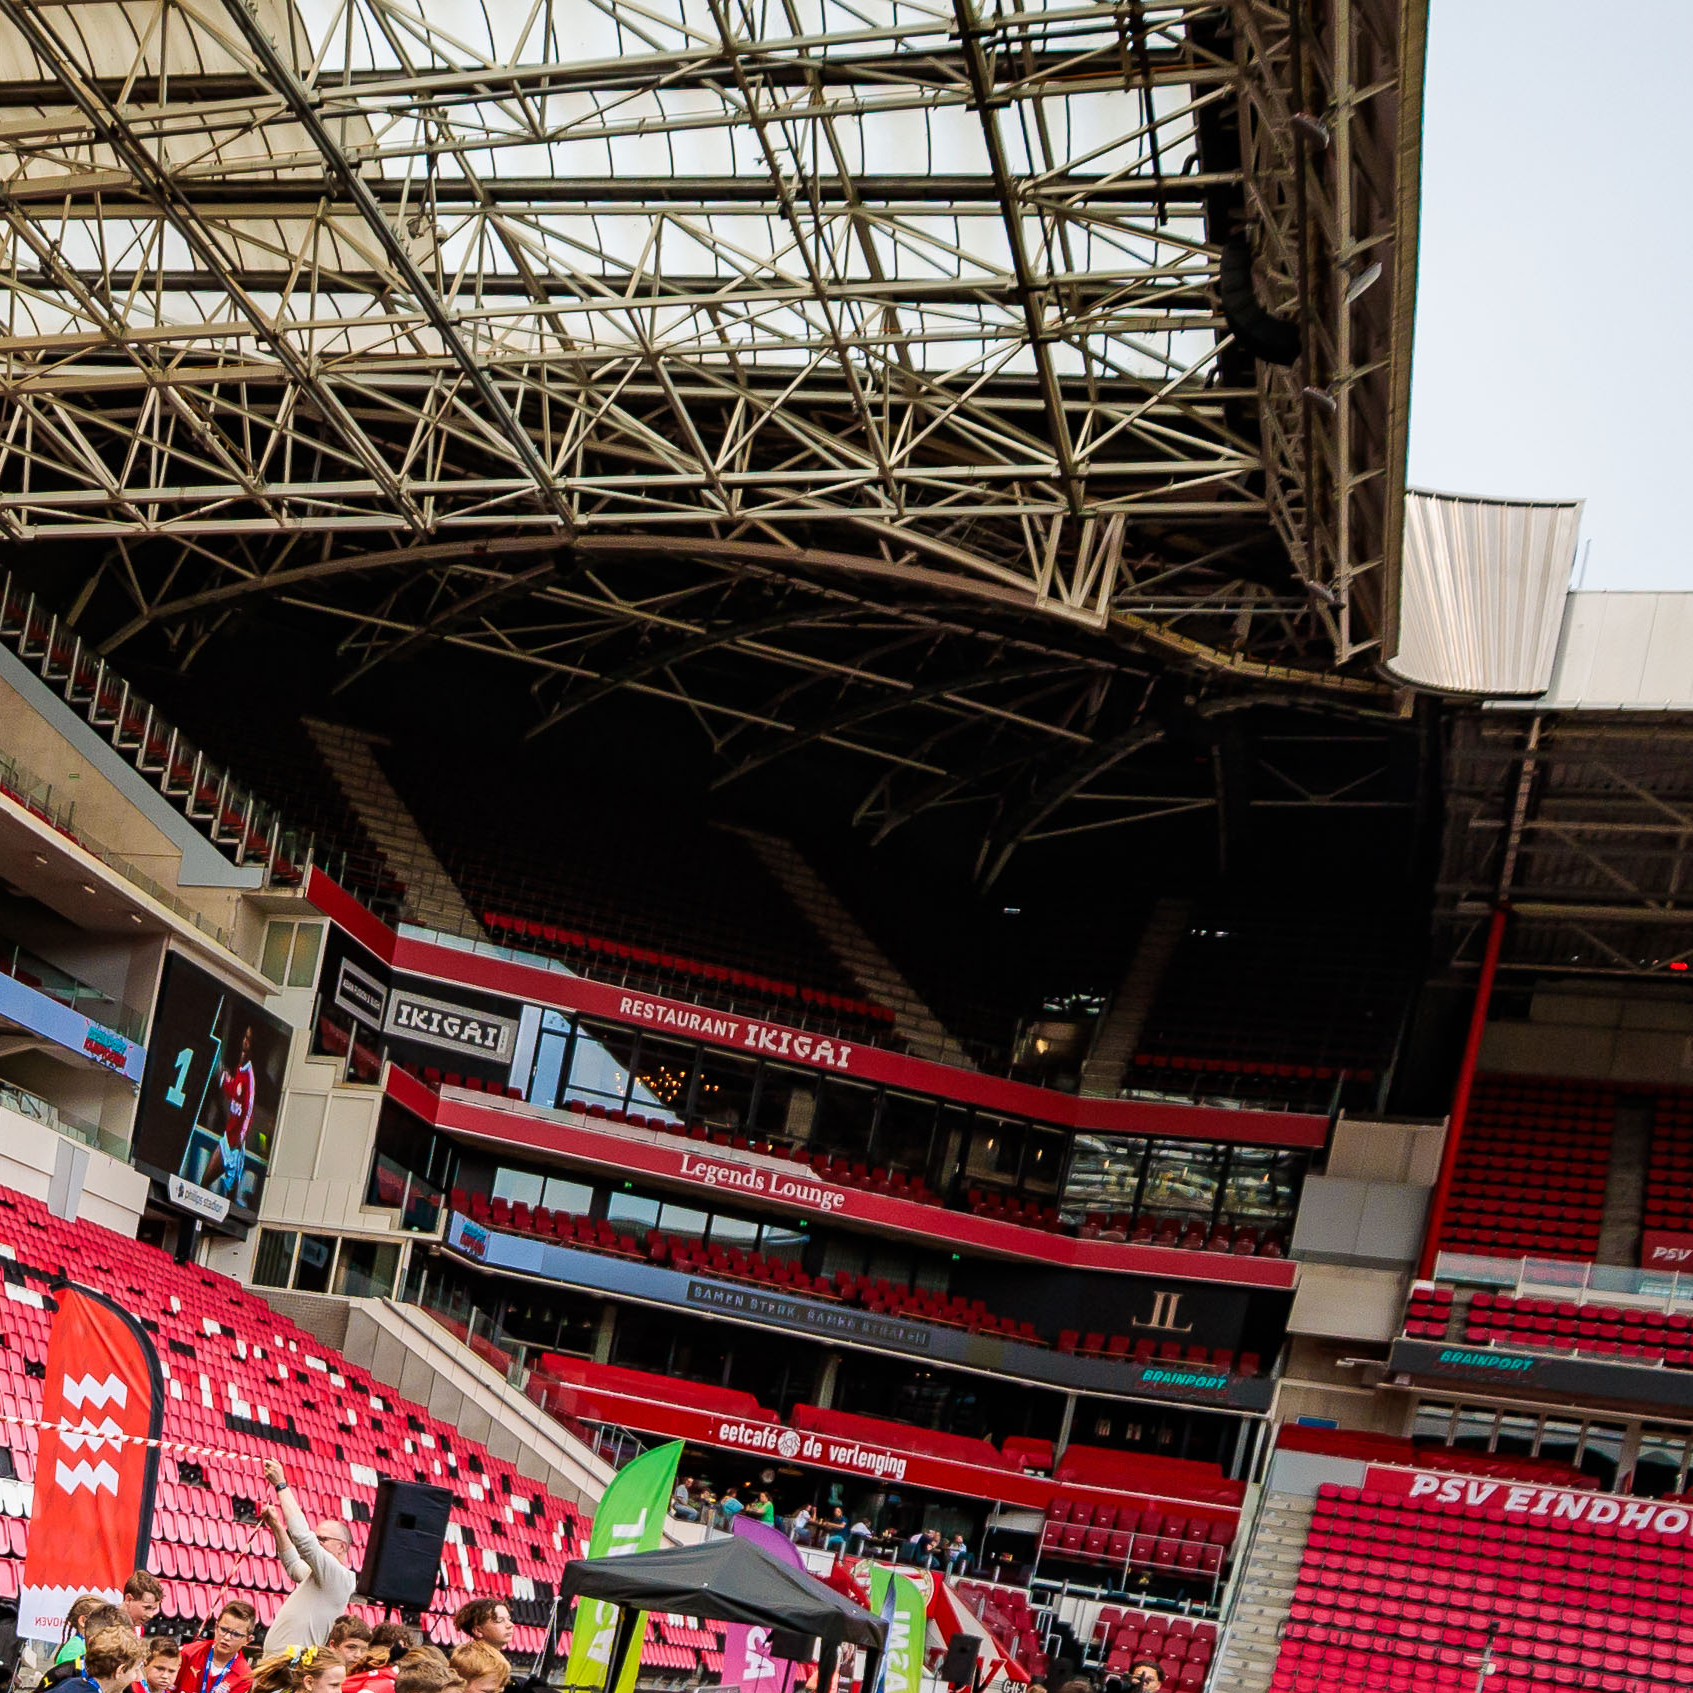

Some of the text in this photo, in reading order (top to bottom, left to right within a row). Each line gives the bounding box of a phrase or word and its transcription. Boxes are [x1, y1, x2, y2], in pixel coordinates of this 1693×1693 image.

[397, 1004, 498, 1048] IKIGAI
[620, 997, 852, 1068] RESTAURANT IKIGAI
[166, 1048, 193, 1109] 1
[680, 1153, 845, 1210] Legends Lounge
[1652, 1246, 1692, 1261] PSV
[694, 1286, 744, 1307] SAMEN
[807, 1309, 856, 1331] SAMEN
[1142, 1368, 1227, 1389] BRAINPORT
[1440, 1350, 1534, 1371] BRAINPORT
[719, 1423, 907, 1480] eetcafé de verlenging
[1409, 1473, 1693, 1534] PSV EINDHO
